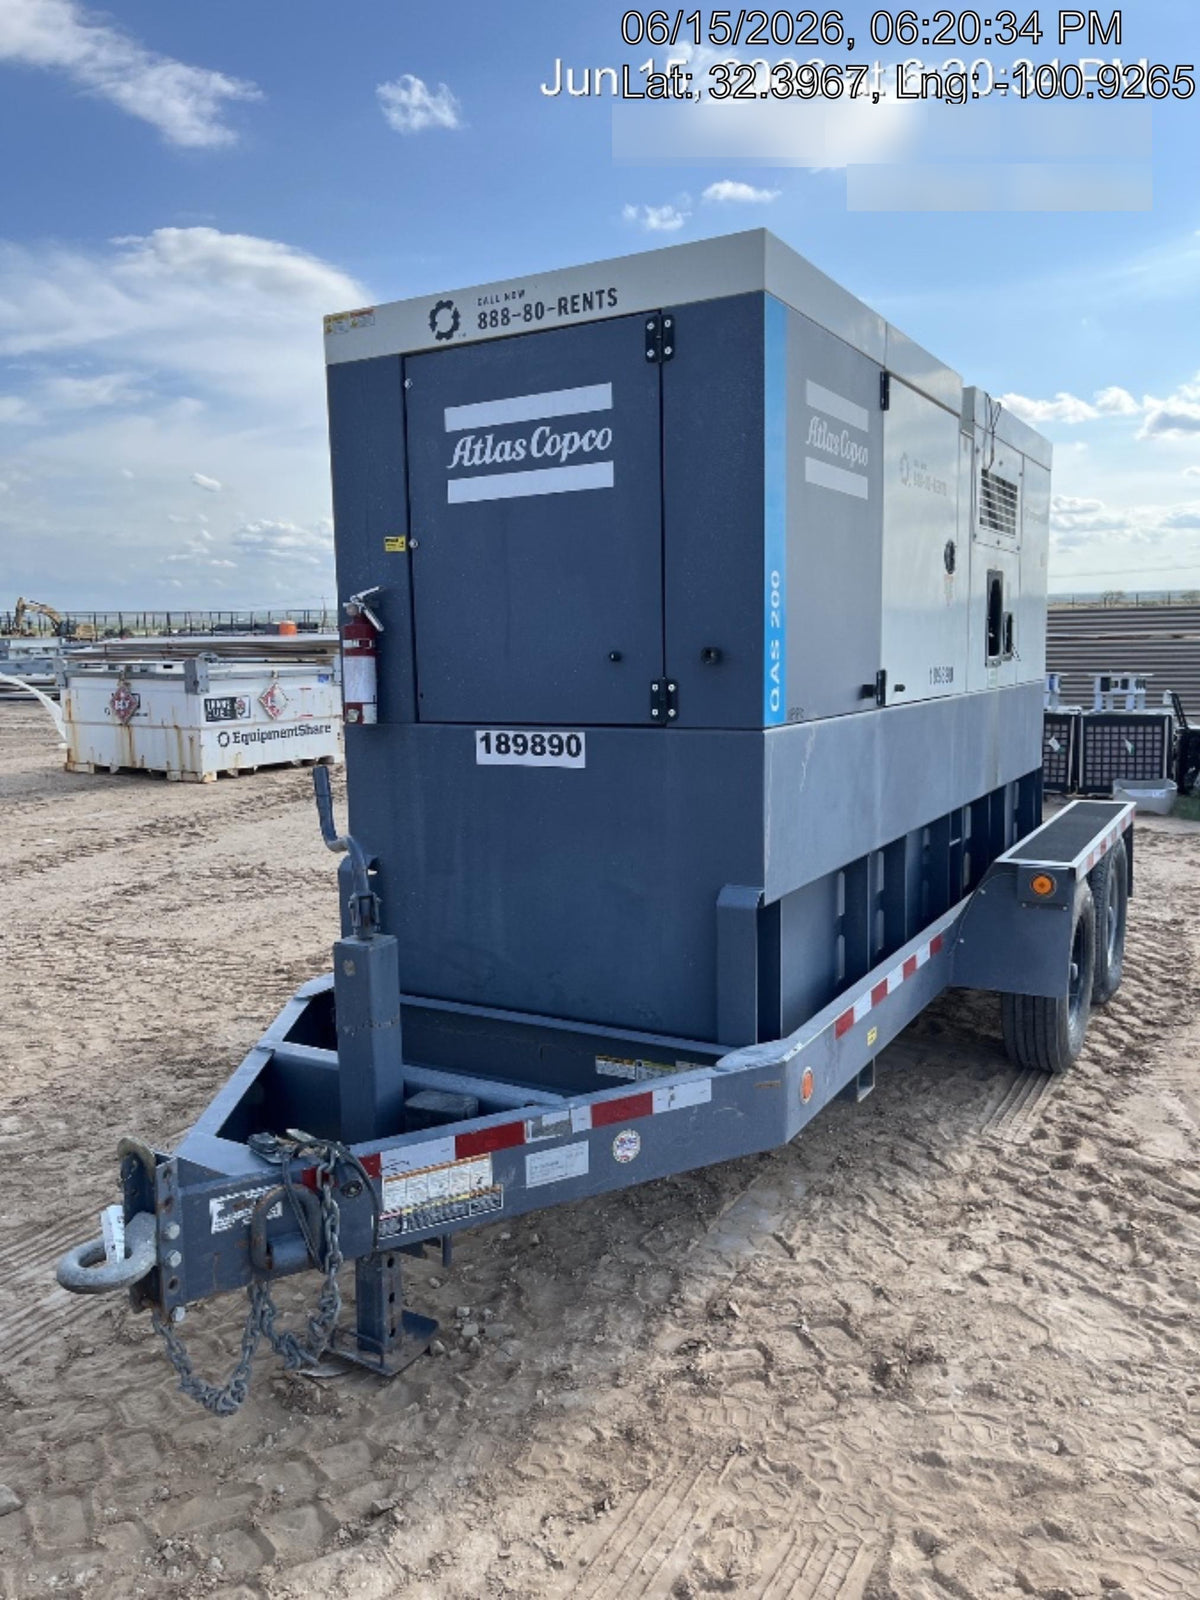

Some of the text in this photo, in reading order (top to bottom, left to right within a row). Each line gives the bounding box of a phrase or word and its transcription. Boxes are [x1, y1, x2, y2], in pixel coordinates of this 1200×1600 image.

[477, 287, 618, 330] 888-80-RENTS
[769, 569, 781, 713] QAS 200
[232, 723, 332, 746] EquipmentShare
[479, 732, 582, 758] 189890
